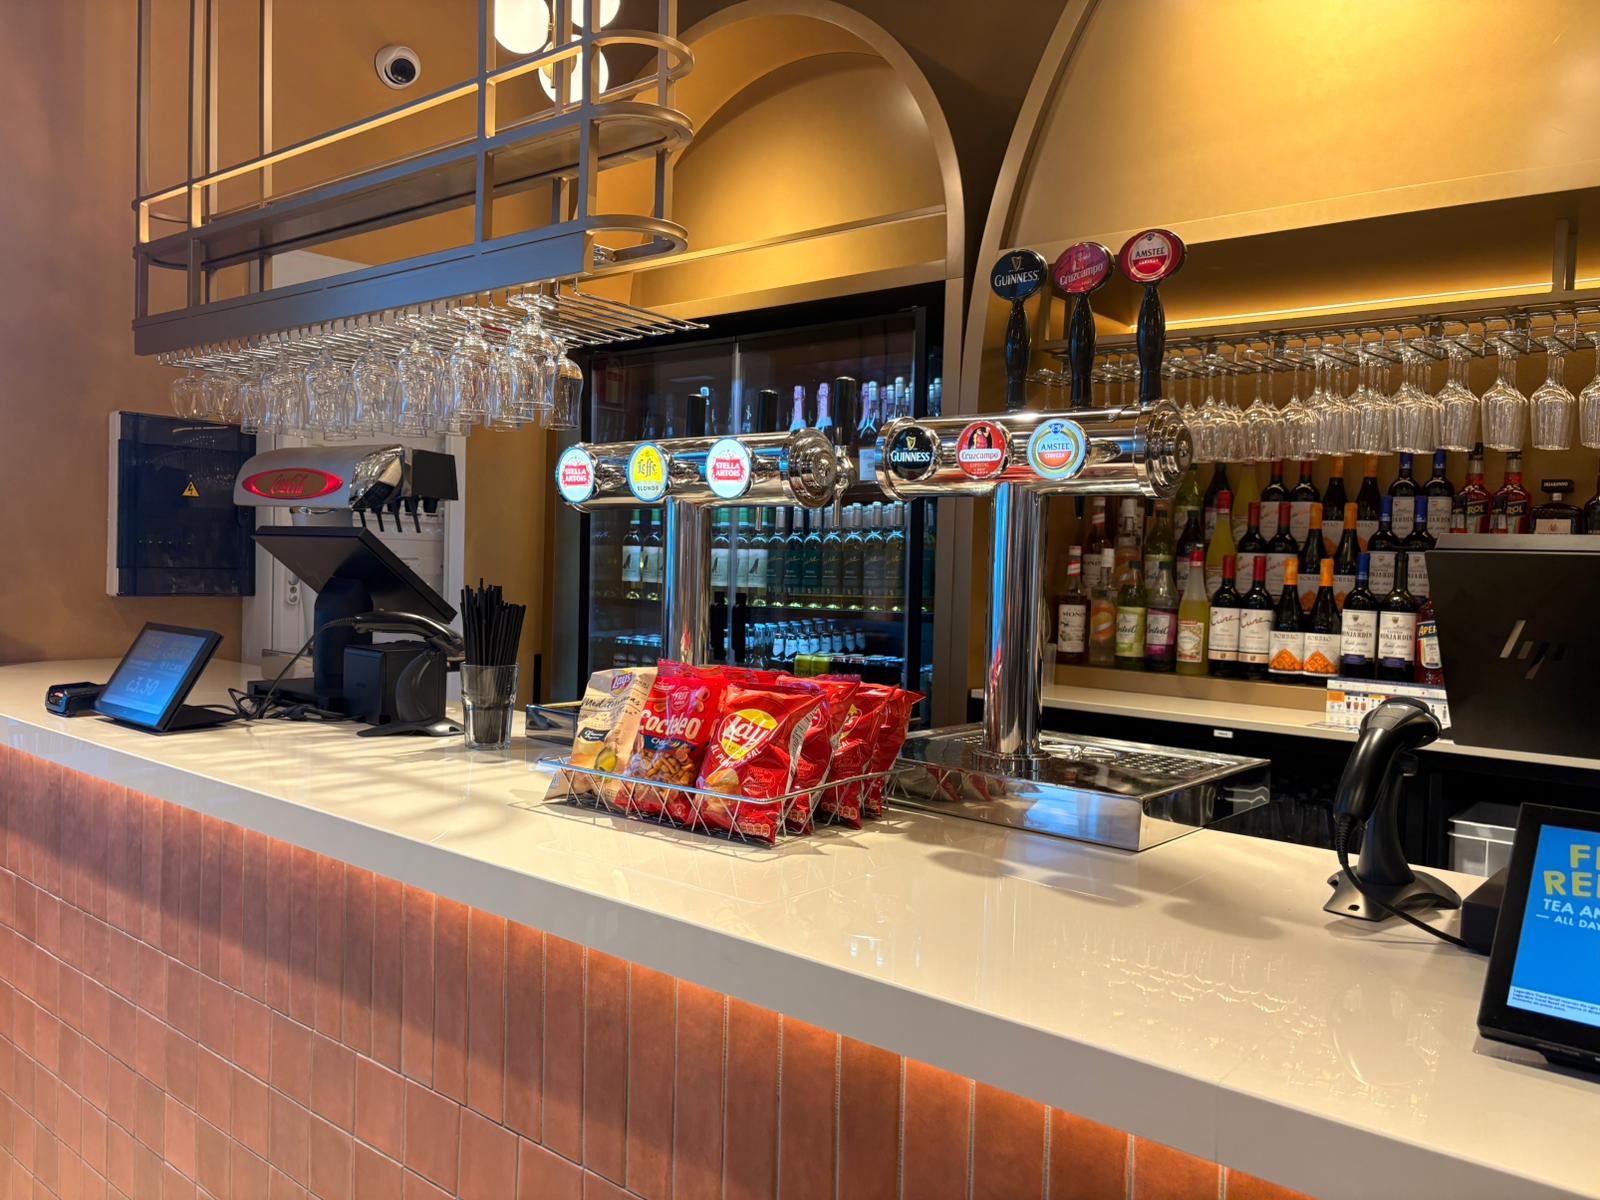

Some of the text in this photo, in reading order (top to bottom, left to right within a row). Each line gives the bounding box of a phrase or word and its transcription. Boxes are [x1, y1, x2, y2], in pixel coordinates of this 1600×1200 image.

[1135, 247, 1166, 257] AMSTEL
[994, 271, 1040, 287] GUINNESS
[1059, 263, 1104, 285] Cruzcampo
[1040, 442, 1071, 451] AMSTEL
[890, 450, 931, 462] GUINNESS
[961, 451, 999, 461] Cruzcampo
[637, 458, 658, 478] Leffe
[716, 461, 741, 470] STELLA
[715, 469, 742, 477] ARTOIS
[1543, 898, 1574, 915] TEA
[1553, 915, 1575, 927] ALL
